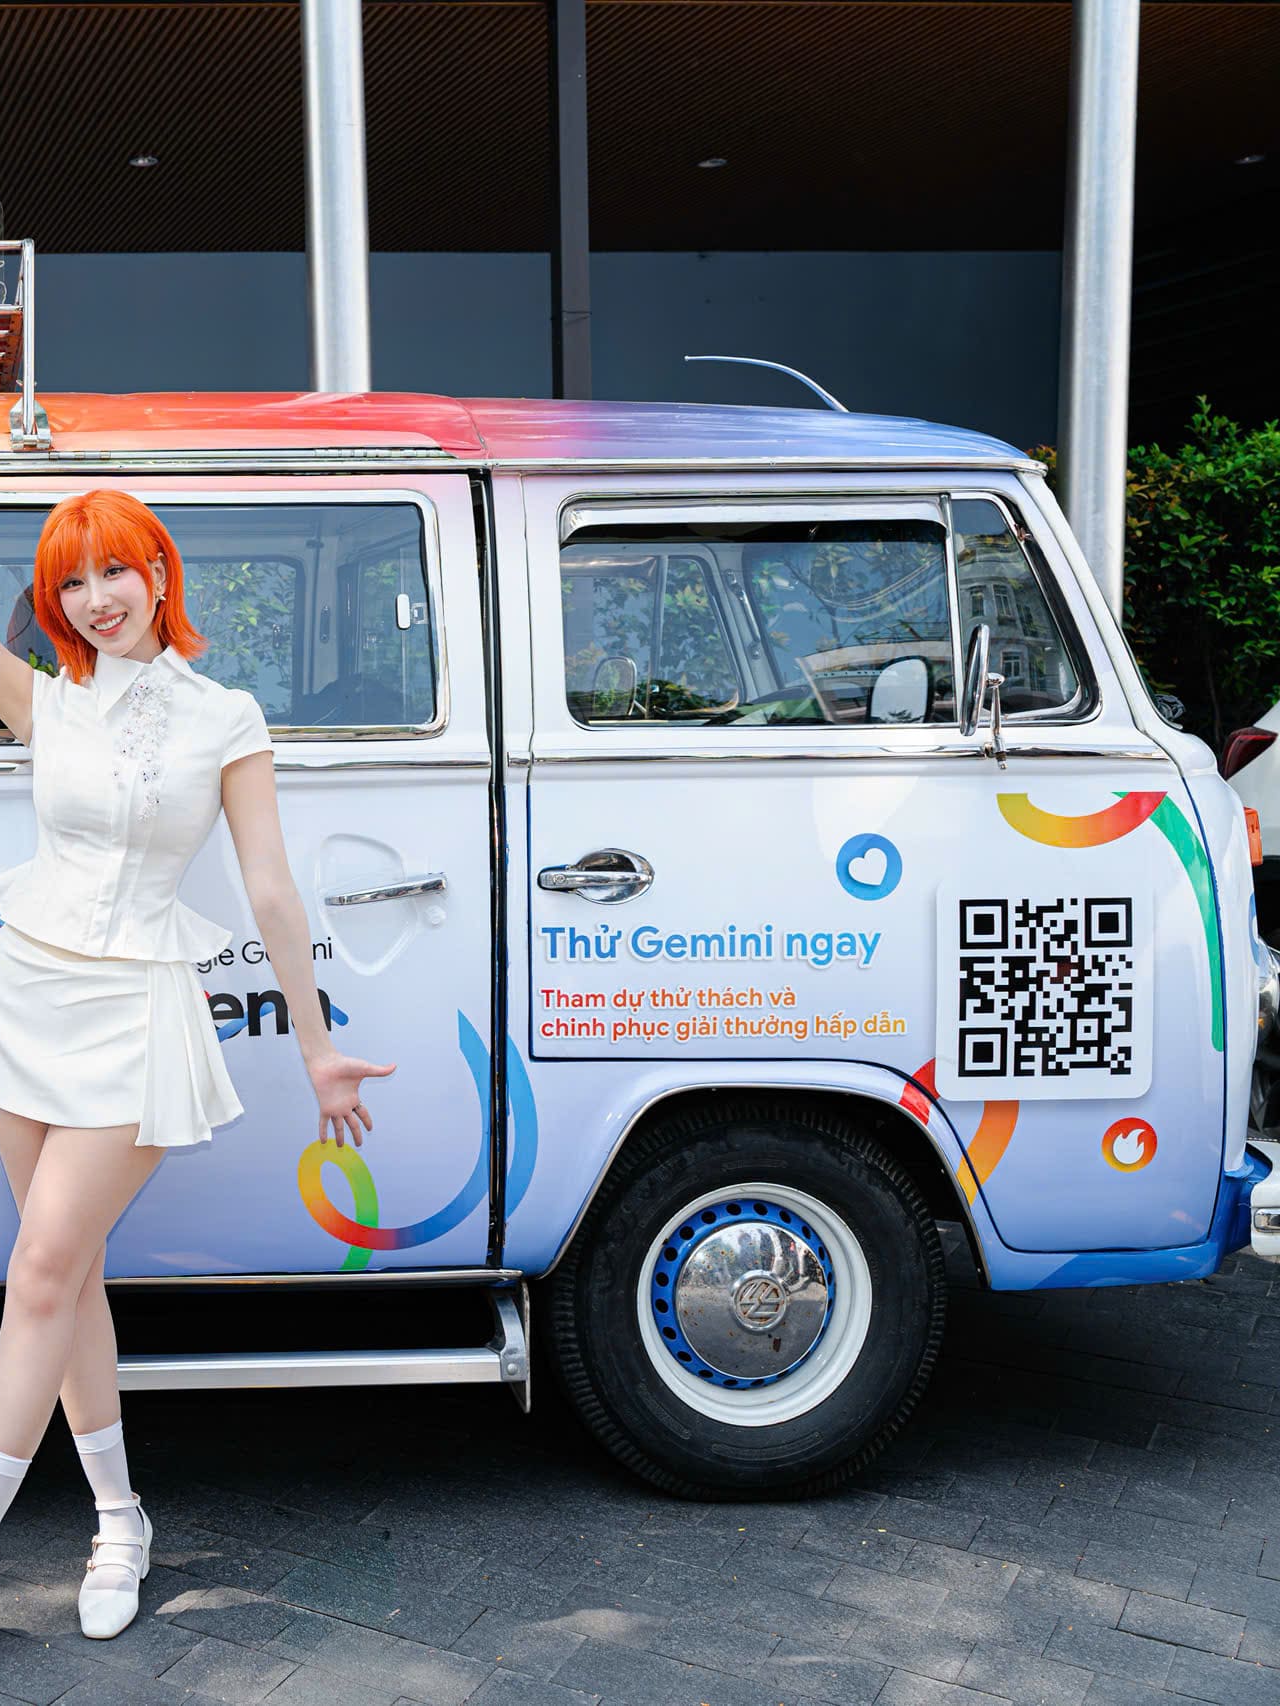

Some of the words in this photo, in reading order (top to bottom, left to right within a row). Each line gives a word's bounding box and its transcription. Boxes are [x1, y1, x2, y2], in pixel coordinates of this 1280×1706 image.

[541, 925, 622, 959] Thử
[631, 925, 773, 958] Gemini
[787, 931, 882, 965] ngay
[541, 989, 606, 1008] Tham
[613, 989, 645, 1012] dự
[650, 987, 691, 1007] thử
[697, 987, 763, 1007] thách
[770, 986, 797, 1006] và
[541, 1017, 606, 1037] chinh
[613, 1018, 670, 1040] phục
[677, 1016, 718, 1039] giải
[724, 1017, 808, 1039] thưởng
[815, 1013, 858, 1038] hấp
[864, 1011, 906, 1034] dẫn
